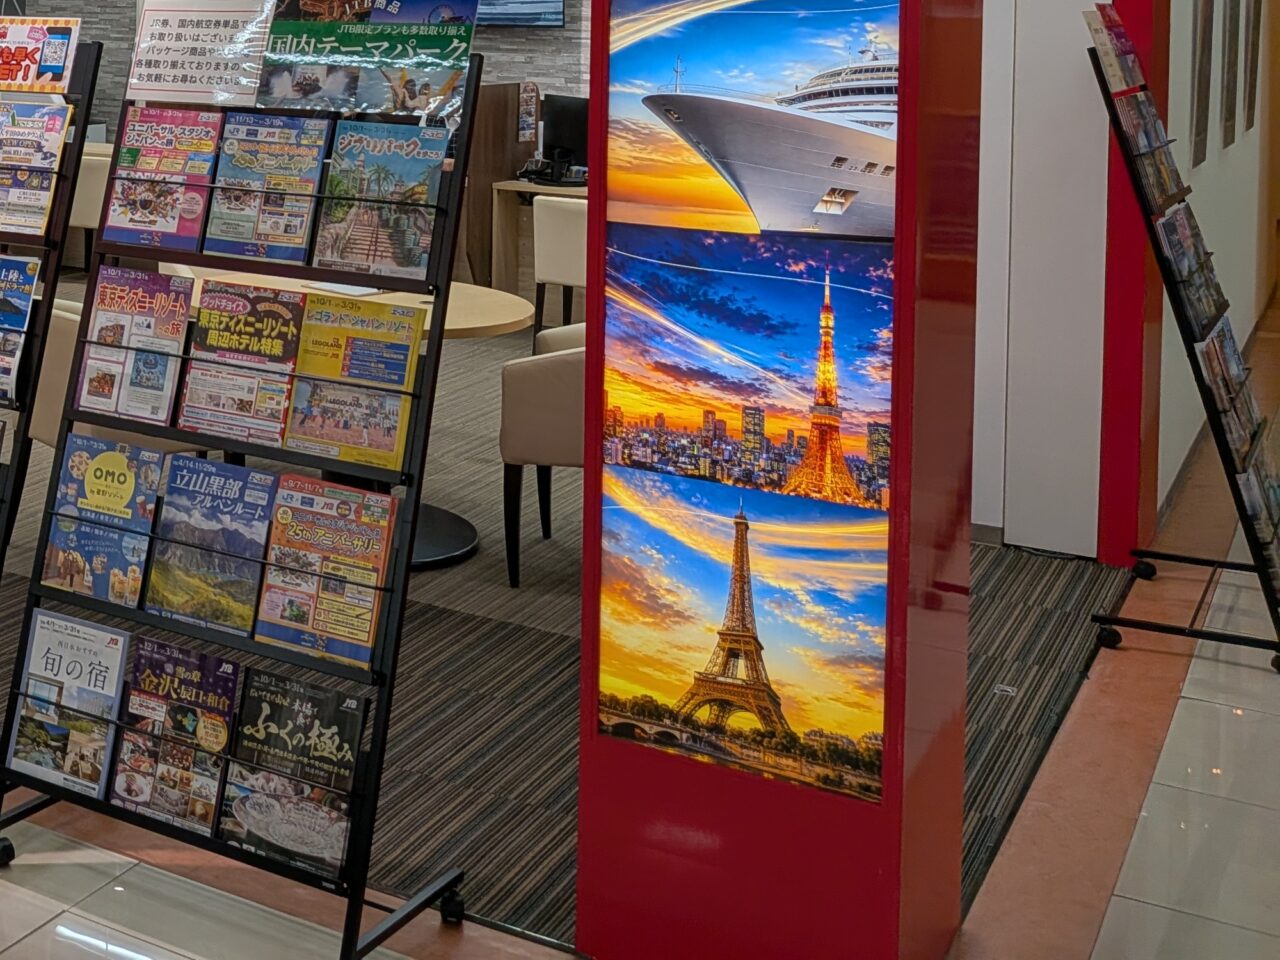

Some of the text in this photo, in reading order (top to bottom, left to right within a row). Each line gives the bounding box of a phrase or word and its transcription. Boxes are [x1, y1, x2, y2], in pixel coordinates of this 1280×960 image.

[150, 18, 256, 30] JR券、国内航空券単品で
[337, 24, 467, 37] JTB限定プランも多数取り揃え
[150, 32, 253, 43] お取り扱いはございま
[269, 34, 468, 60] 国内テーマパーク
[136, 59, 250, 72] 各種取り揃えておりますの
[137, 72, 251, 86] お気軽にお尋ねくださいま
[97, 283, 186, 320] 東京ディズニーリゾート
[199, 310, 298, 340] 東京ディズニーリゾート
[207, 329, 285, 358] 周辺ホテル特集
[93, 466, 128, 486] OMO
[170, 469, 244, 499] 立山黒部
[191, 494, 265, 520] アルペンルート
[40, 646, 110, 691] 旬の宿
[242, 701, 355, 763] ふくの極み
